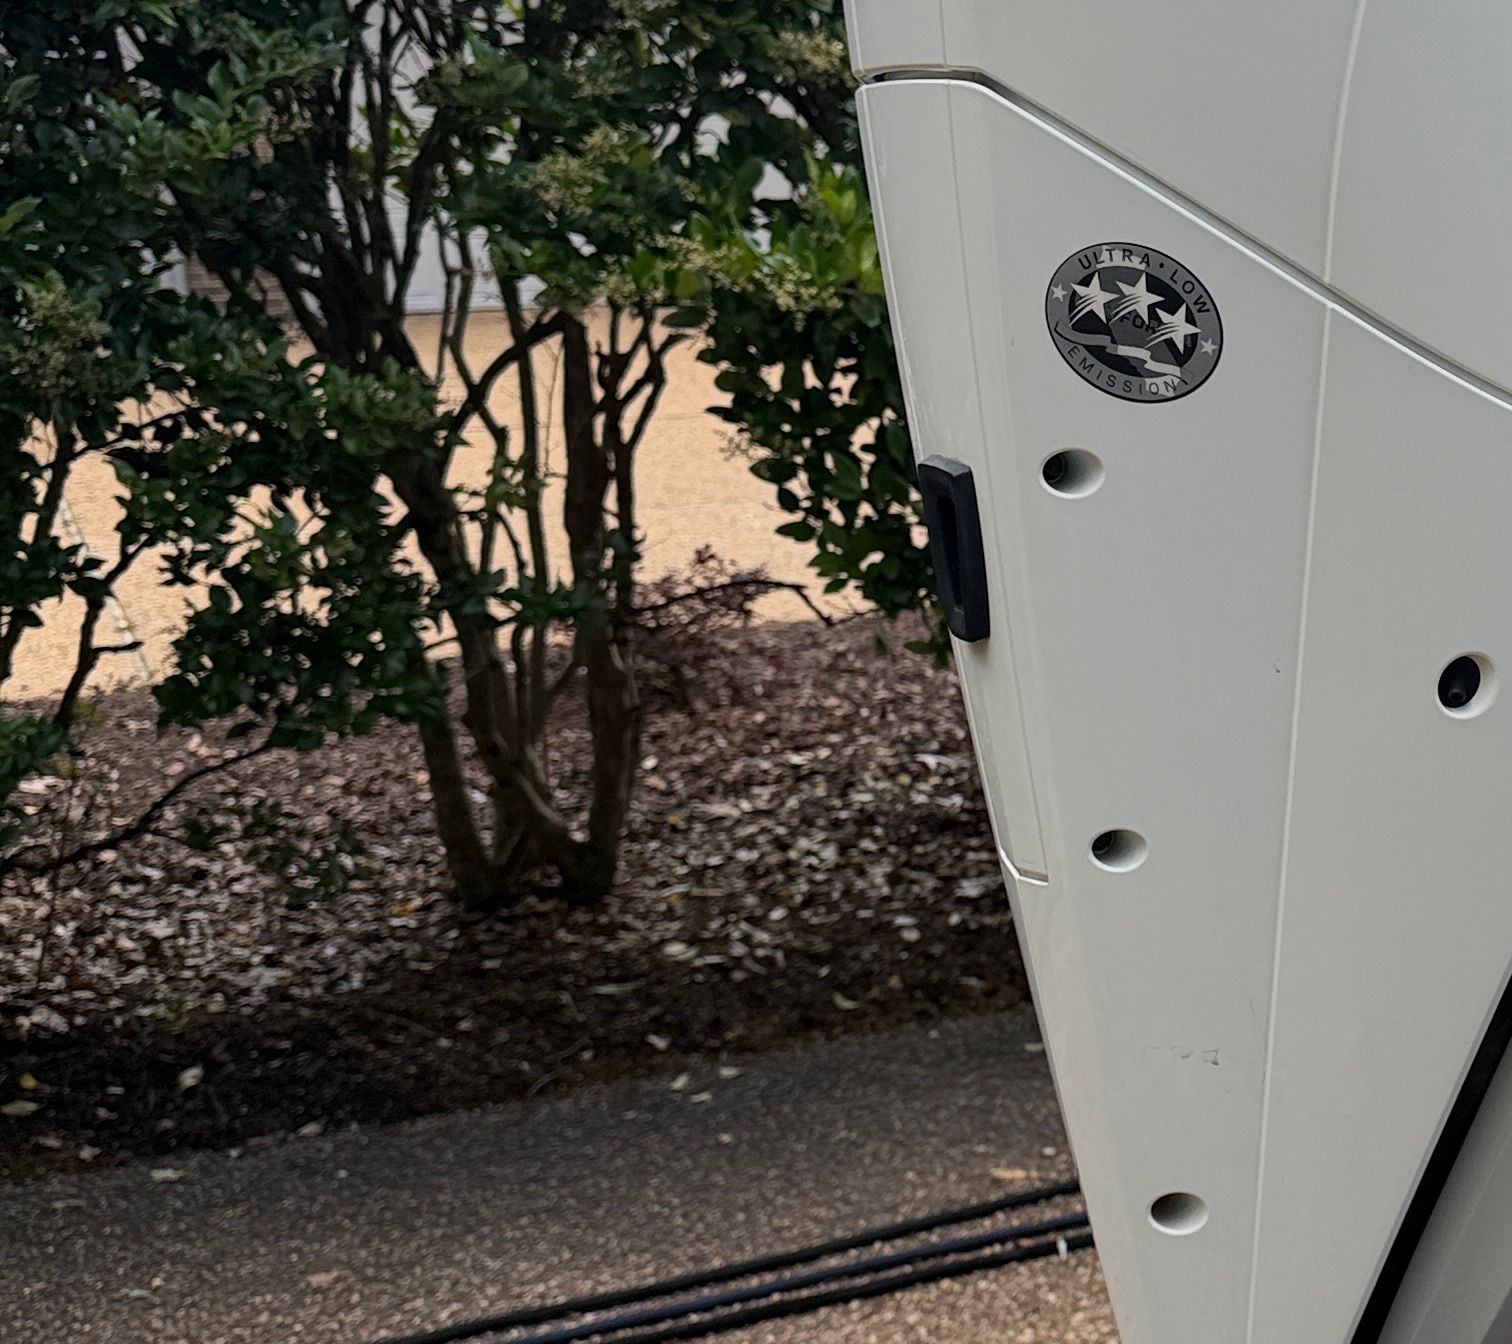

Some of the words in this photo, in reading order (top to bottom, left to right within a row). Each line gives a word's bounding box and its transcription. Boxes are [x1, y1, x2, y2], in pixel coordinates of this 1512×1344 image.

[1078, 248, 1151, 271] ULTRA
[1169, 268, 1210, 315] LOW
[1067, 345, 1178, 396] EMISSION
